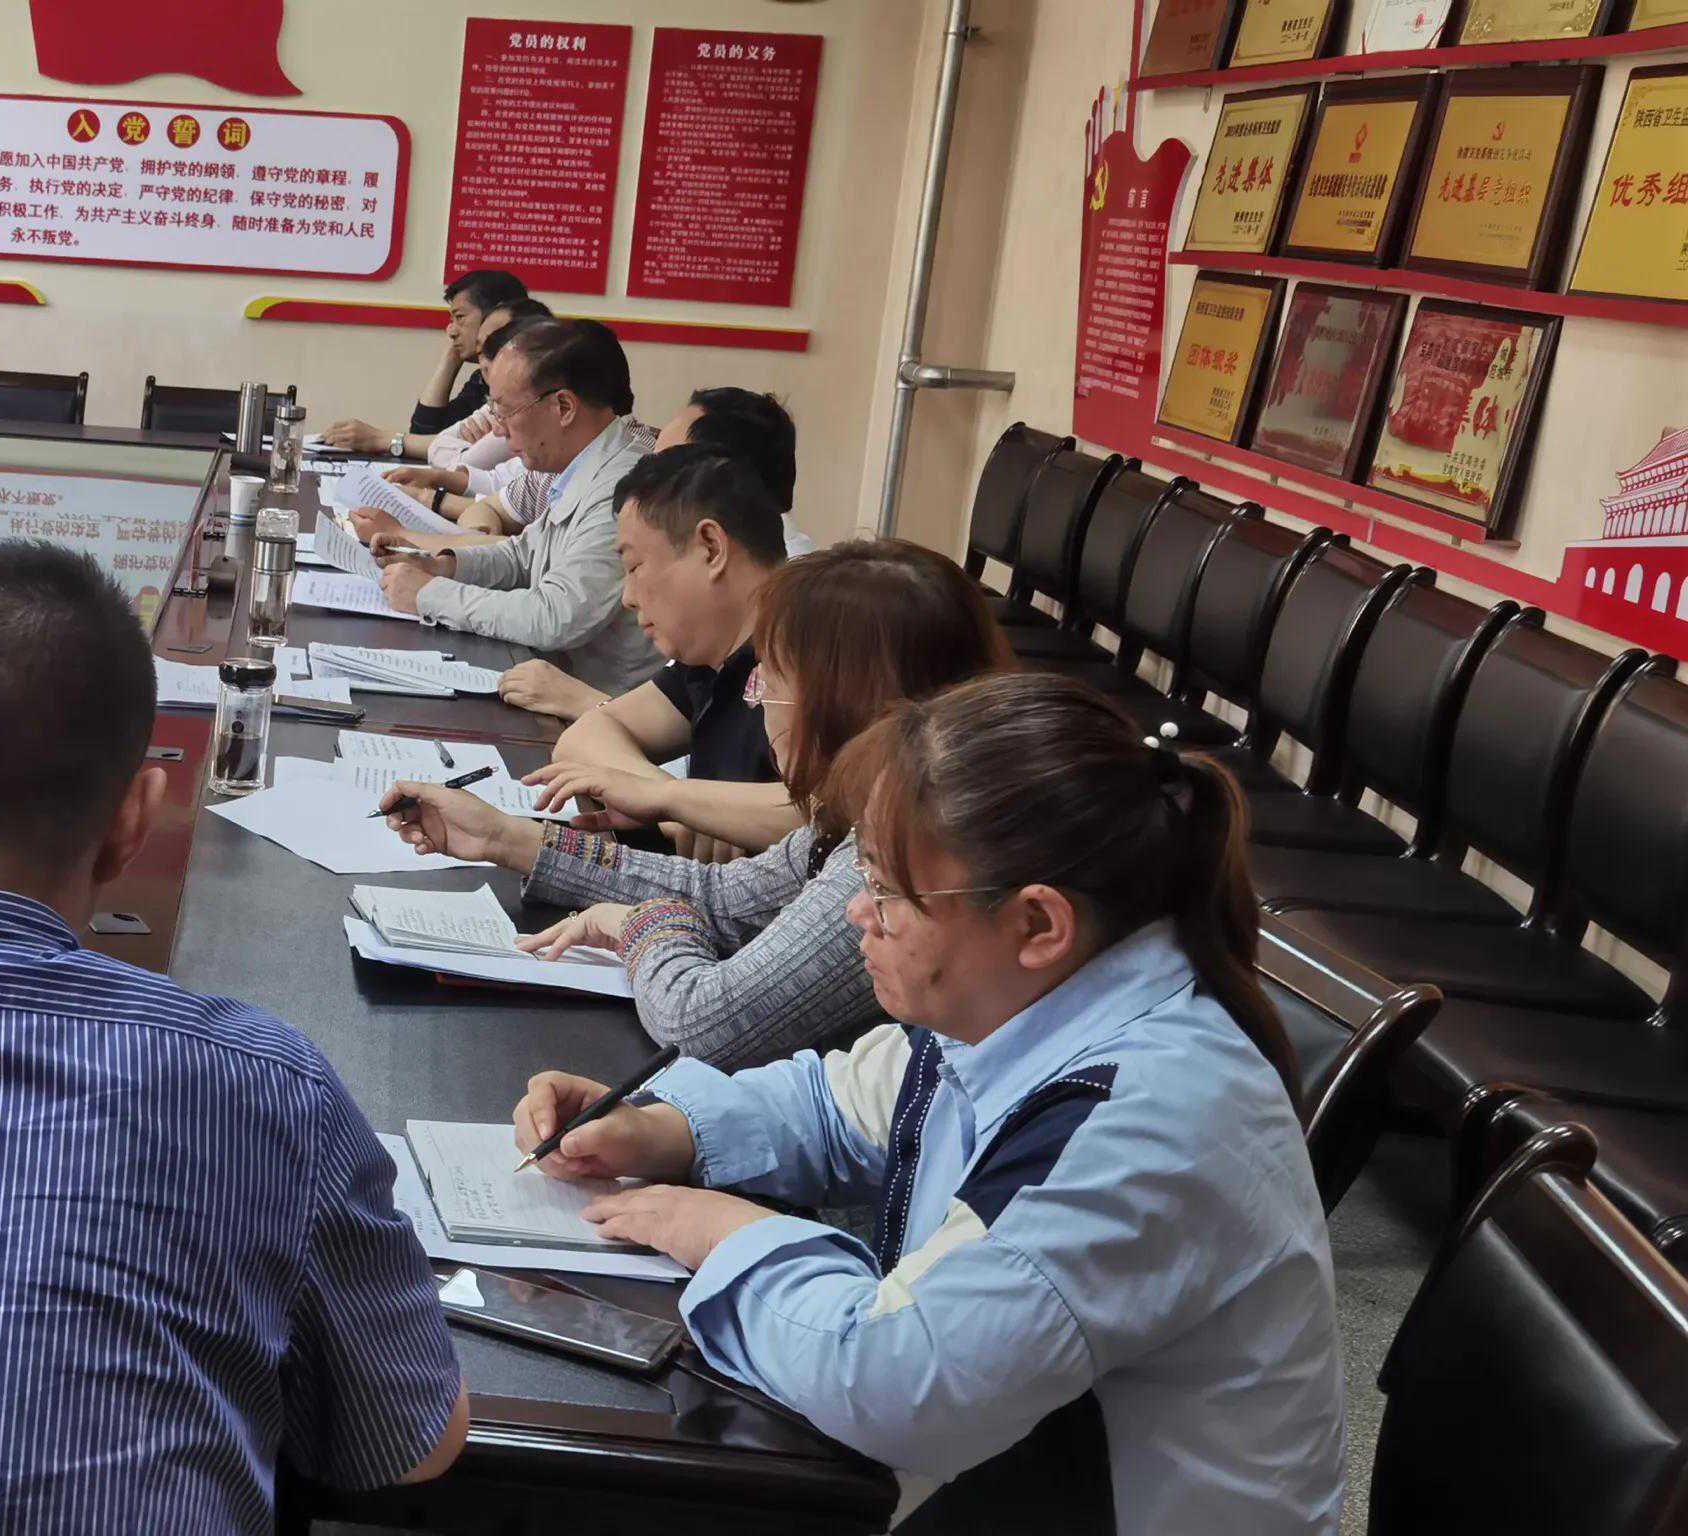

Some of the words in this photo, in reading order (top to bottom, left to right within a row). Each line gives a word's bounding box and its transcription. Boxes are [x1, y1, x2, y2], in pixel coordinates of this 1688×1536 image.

[509, 32, 587, 52] 党员的权利
[697, 42, 776, 61] 党员的义务
[72, 112, 248, 147] 入党誓词
[1610, 172, 1688, 208] 优秀组
